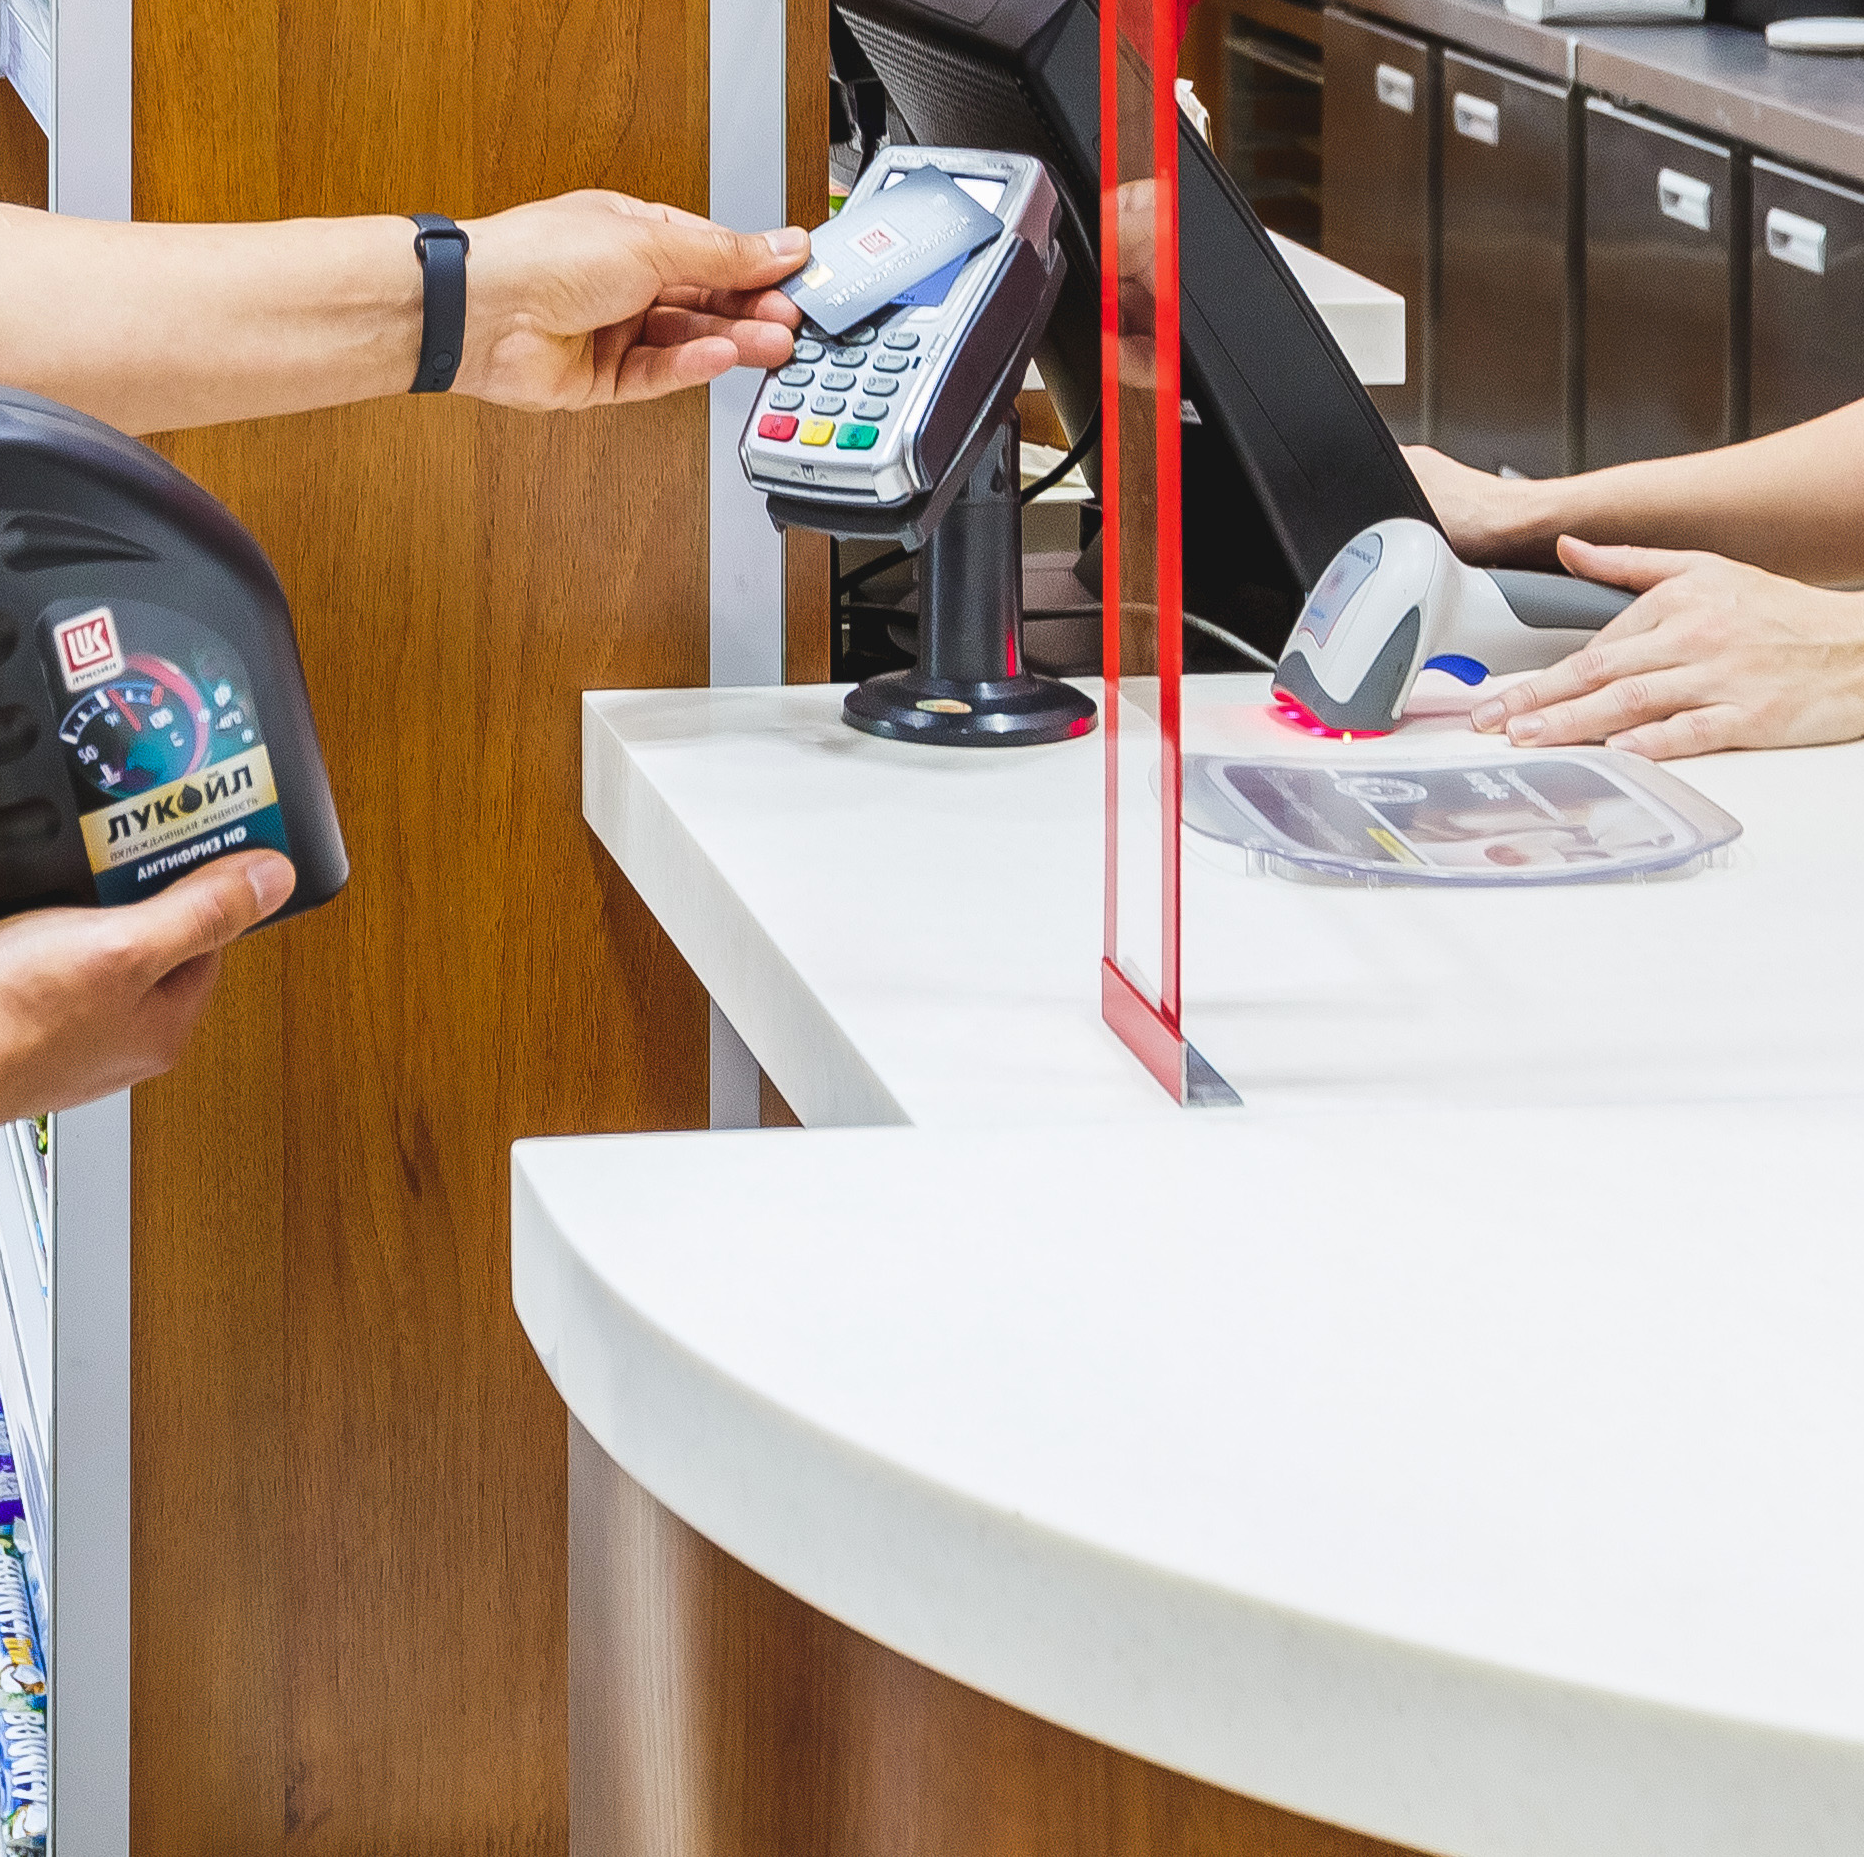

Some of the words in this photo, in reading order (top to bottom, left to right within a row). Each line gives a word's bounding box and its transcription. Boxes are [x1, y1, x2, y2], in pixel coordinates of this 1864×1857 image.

[107, 763, 254, 845] ЛУКОЙЛ
[137, 836, 222, 883] АНТИФРИЗ
[2, 1710, 48, 1802] BOUNTY
